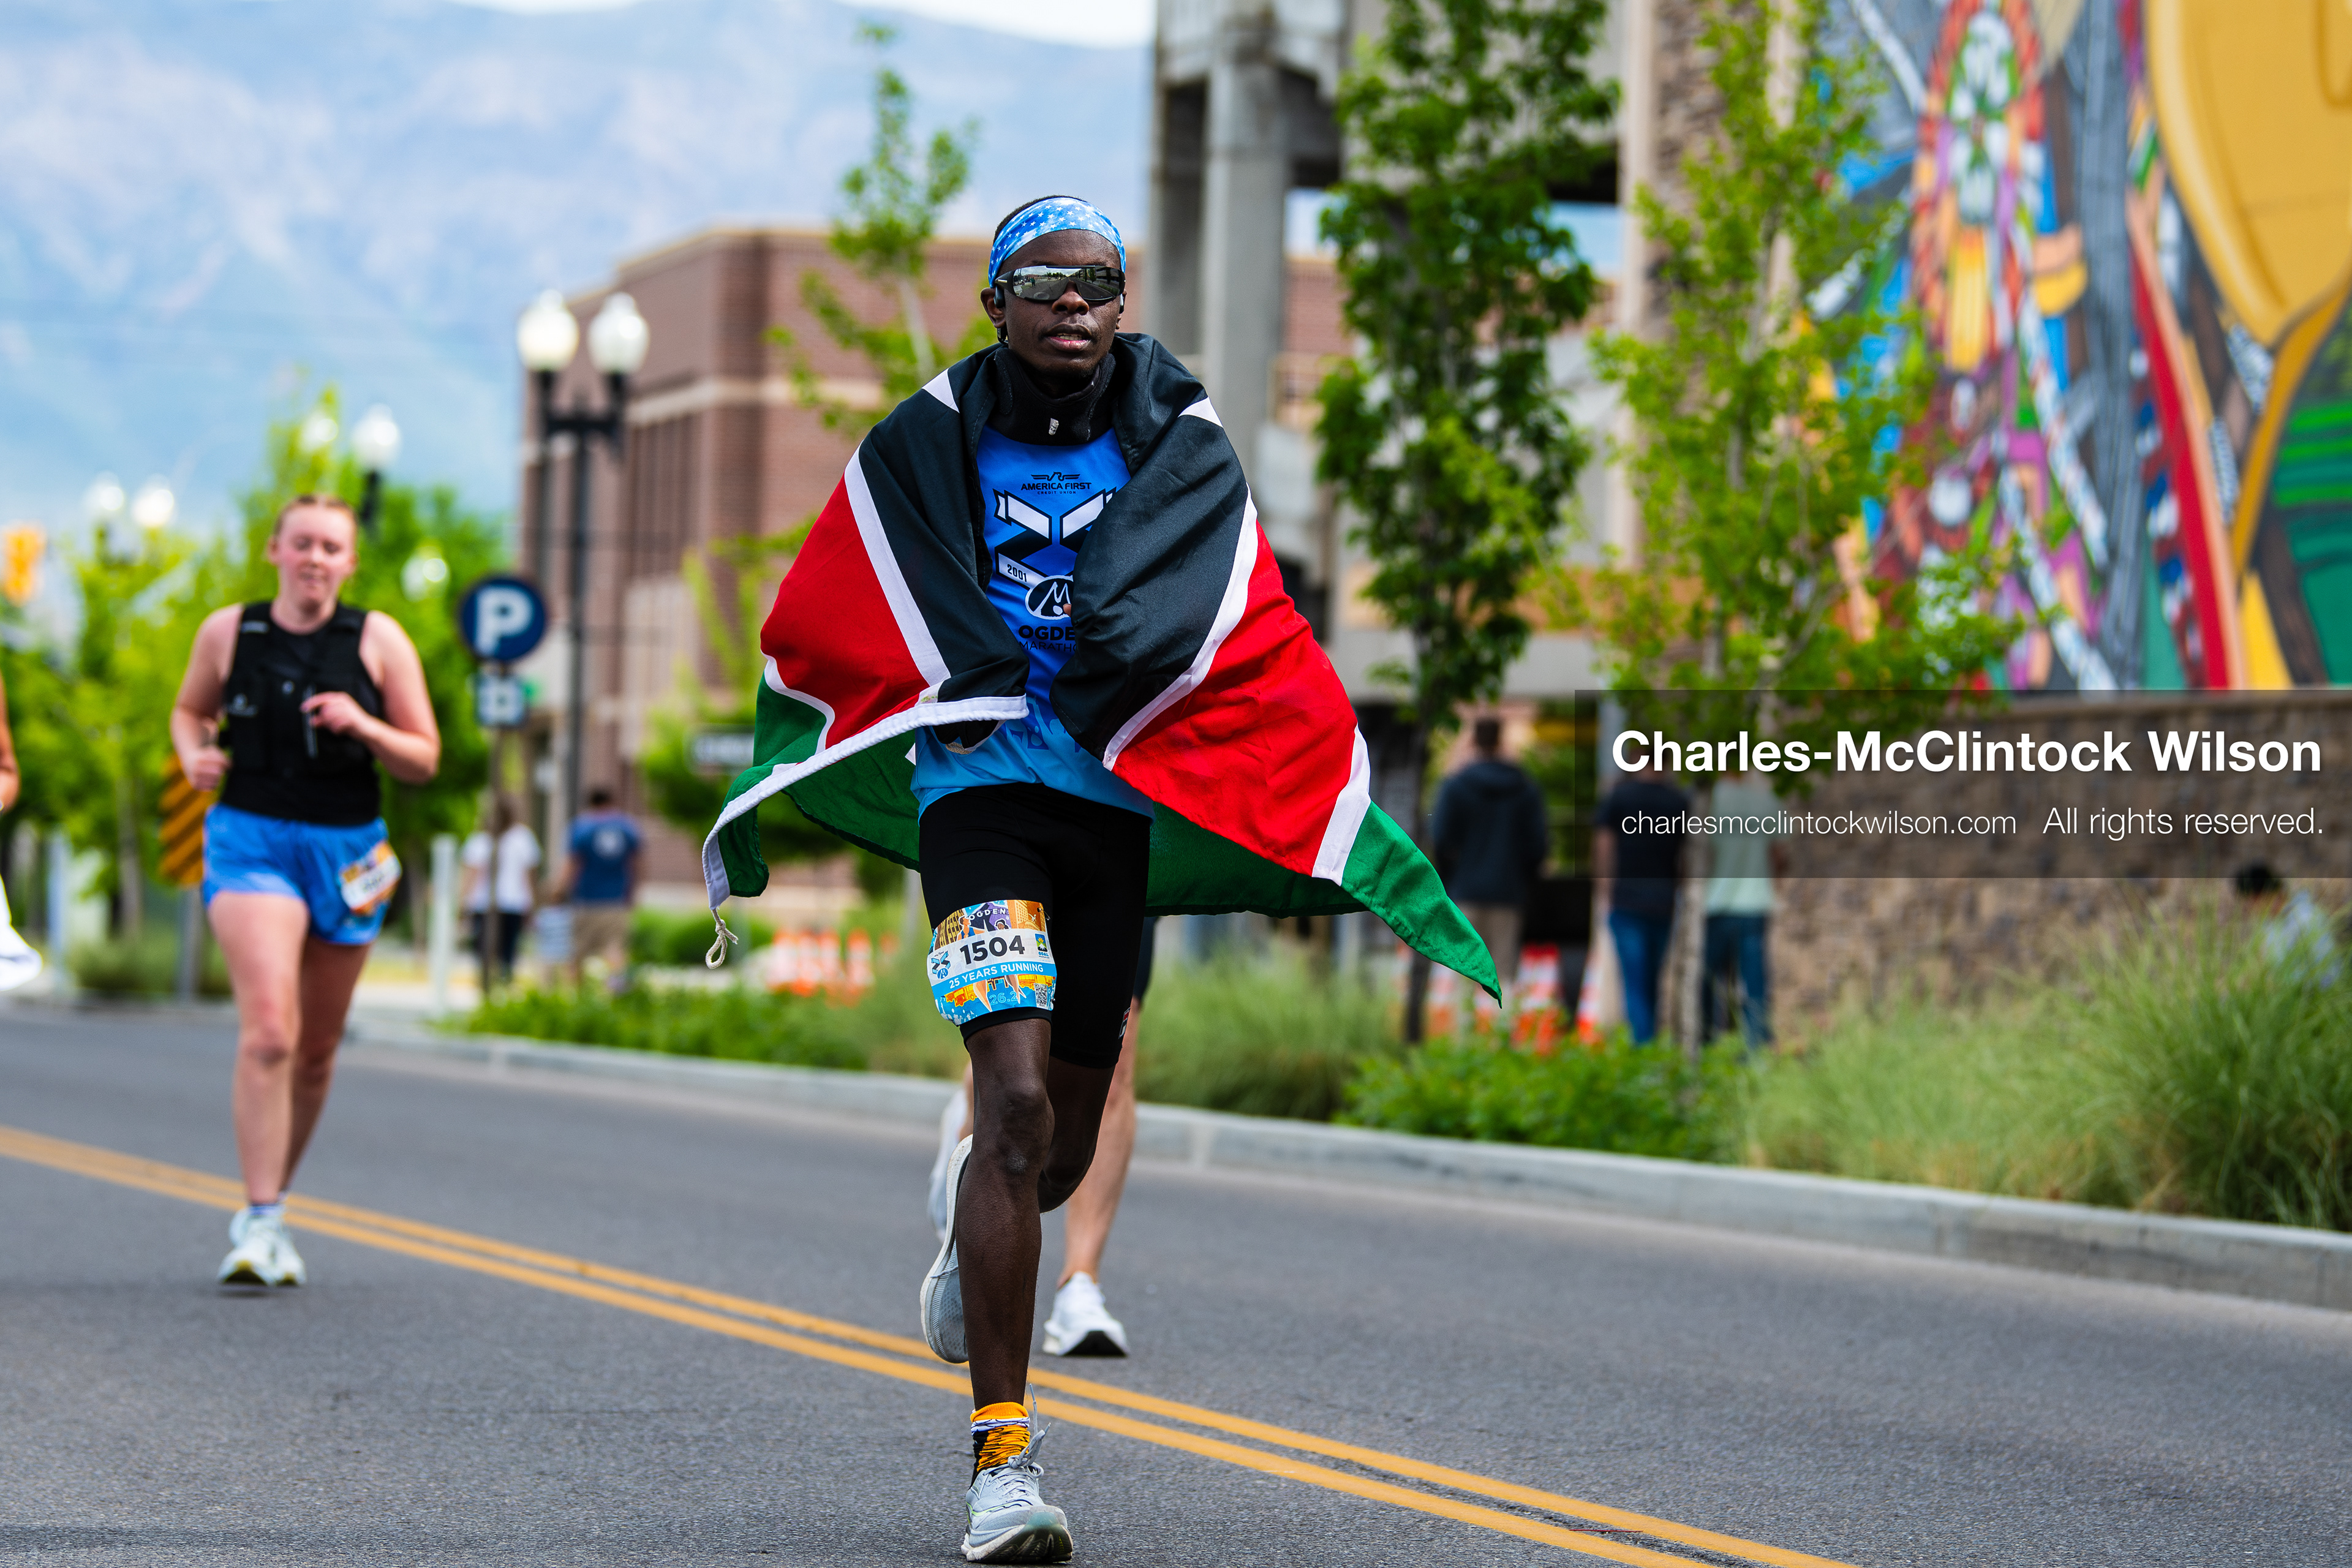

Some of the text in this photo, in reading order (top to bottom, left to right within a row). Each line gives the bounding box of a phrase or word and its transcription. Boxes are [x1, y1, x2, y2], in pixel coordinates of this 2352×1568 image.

[1007, 564, 1027, 582] 2001
[475, 585, 534, 657] P
[1018, 625, 1076, 641] OGDE
[1019, 641, 1077, 652] MARATH
[969, 908, 1006, 920] OGDEN
[960, 935, 1025, 965] 1504
[949, 963, 1044, 989] 25 YEARS RUNNING
[989, 991, 1018, 1005] 26.2
